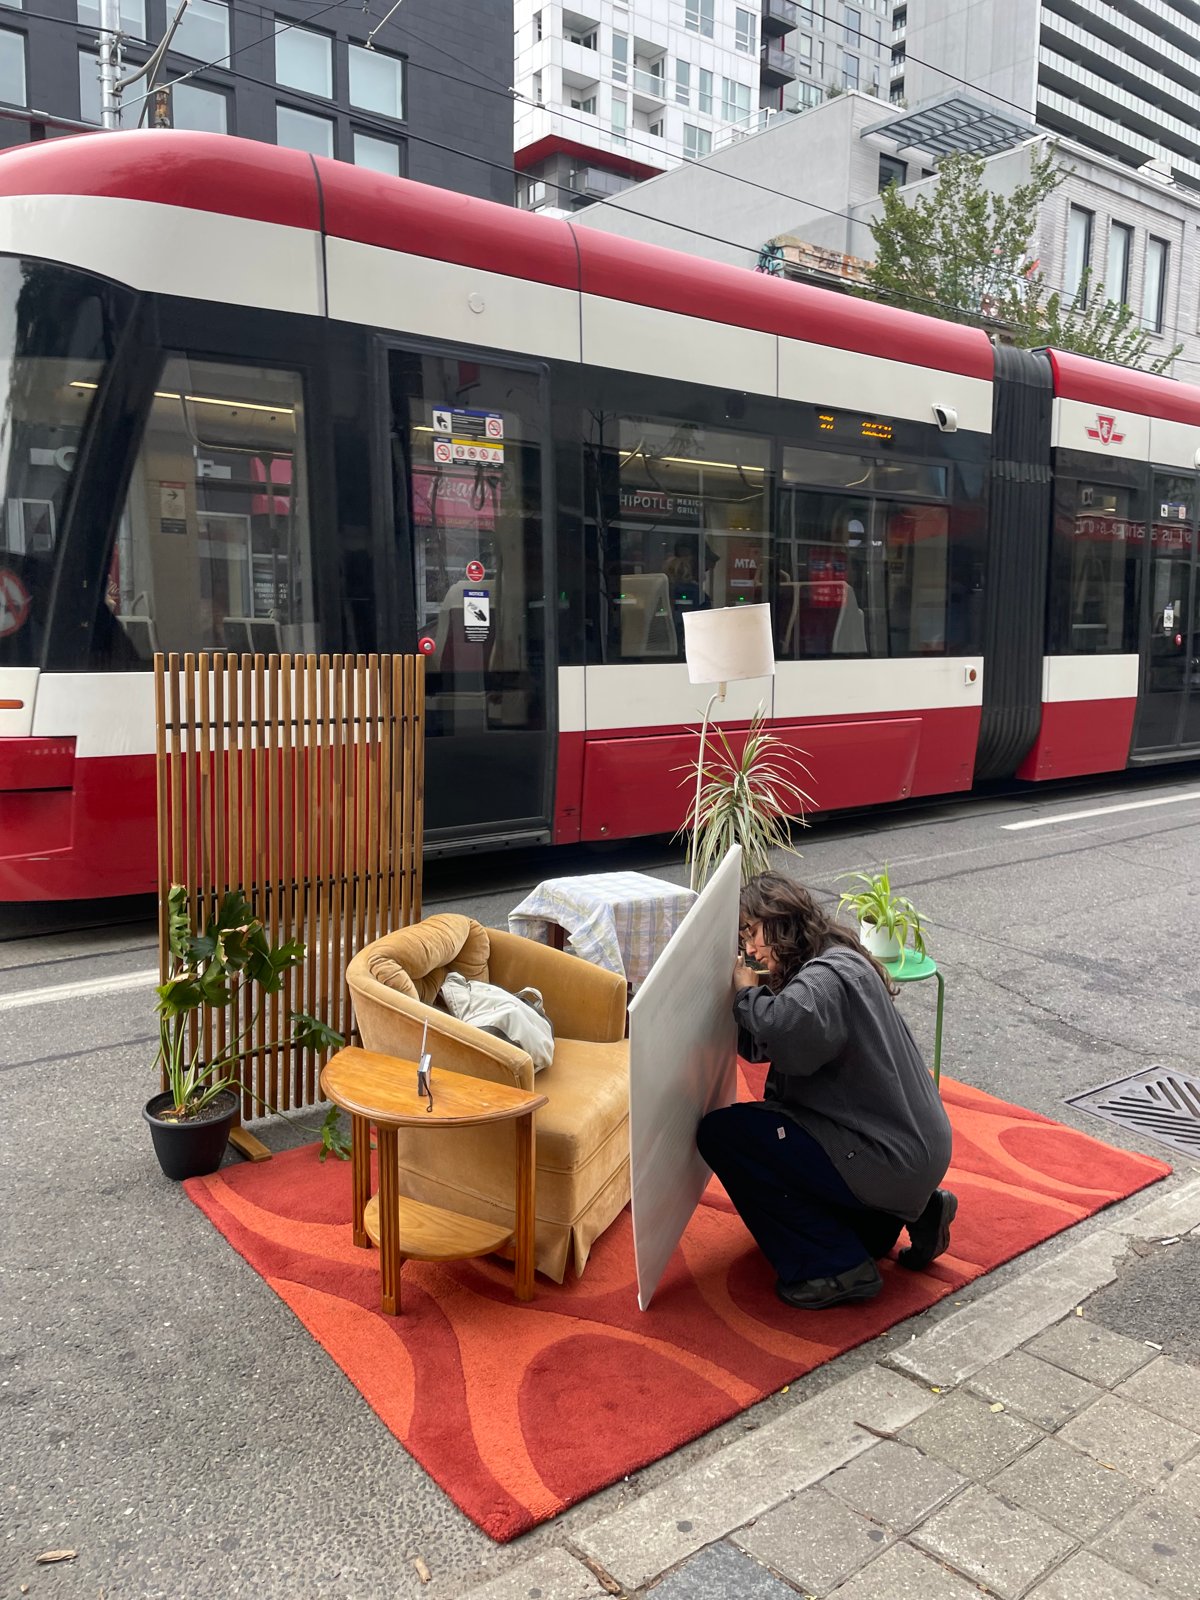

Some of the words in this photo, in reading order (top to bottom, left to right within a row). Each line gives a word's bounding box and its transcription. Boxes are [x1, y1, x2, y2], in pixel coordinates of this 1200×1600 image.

[619, 494, 673, 510] HIPOTLE
[677, 498, 703, 507] MEXIC
[677, 506, 698, 515] GRILL
[734, 558, 757, 569] MTA
